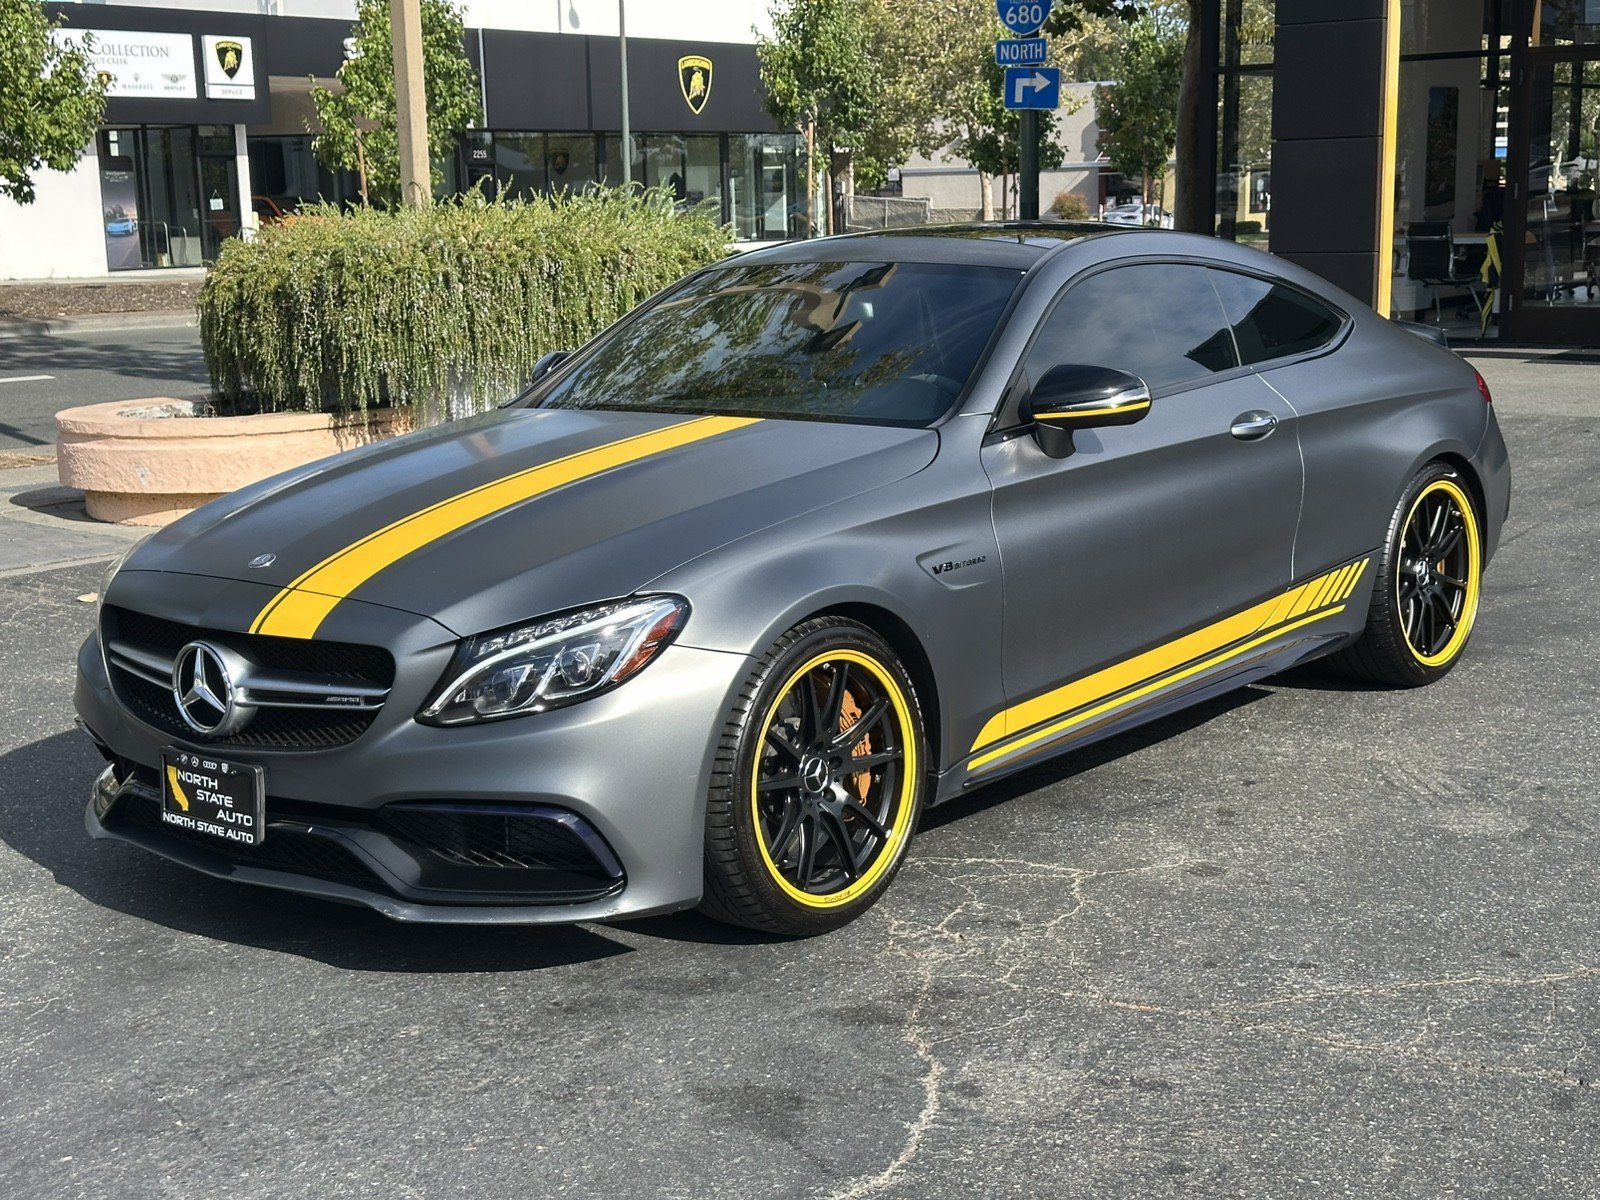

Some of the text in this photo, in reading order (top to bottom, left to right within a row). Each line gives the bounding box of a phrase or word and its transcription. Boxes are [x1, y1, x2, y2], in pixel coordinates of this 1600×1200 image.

[1005, 4, 1042, 25] 680
[1000, 42, 1043, 60] NORTH
[931, 561, 954, 575] V8
[177, 769, 218, 790] NORTH
[196, 789, 233, 808] STATE
[216, 808, 253, 827] AUTO
[162, 811, 254, 844] NORTH STATE AUTO
